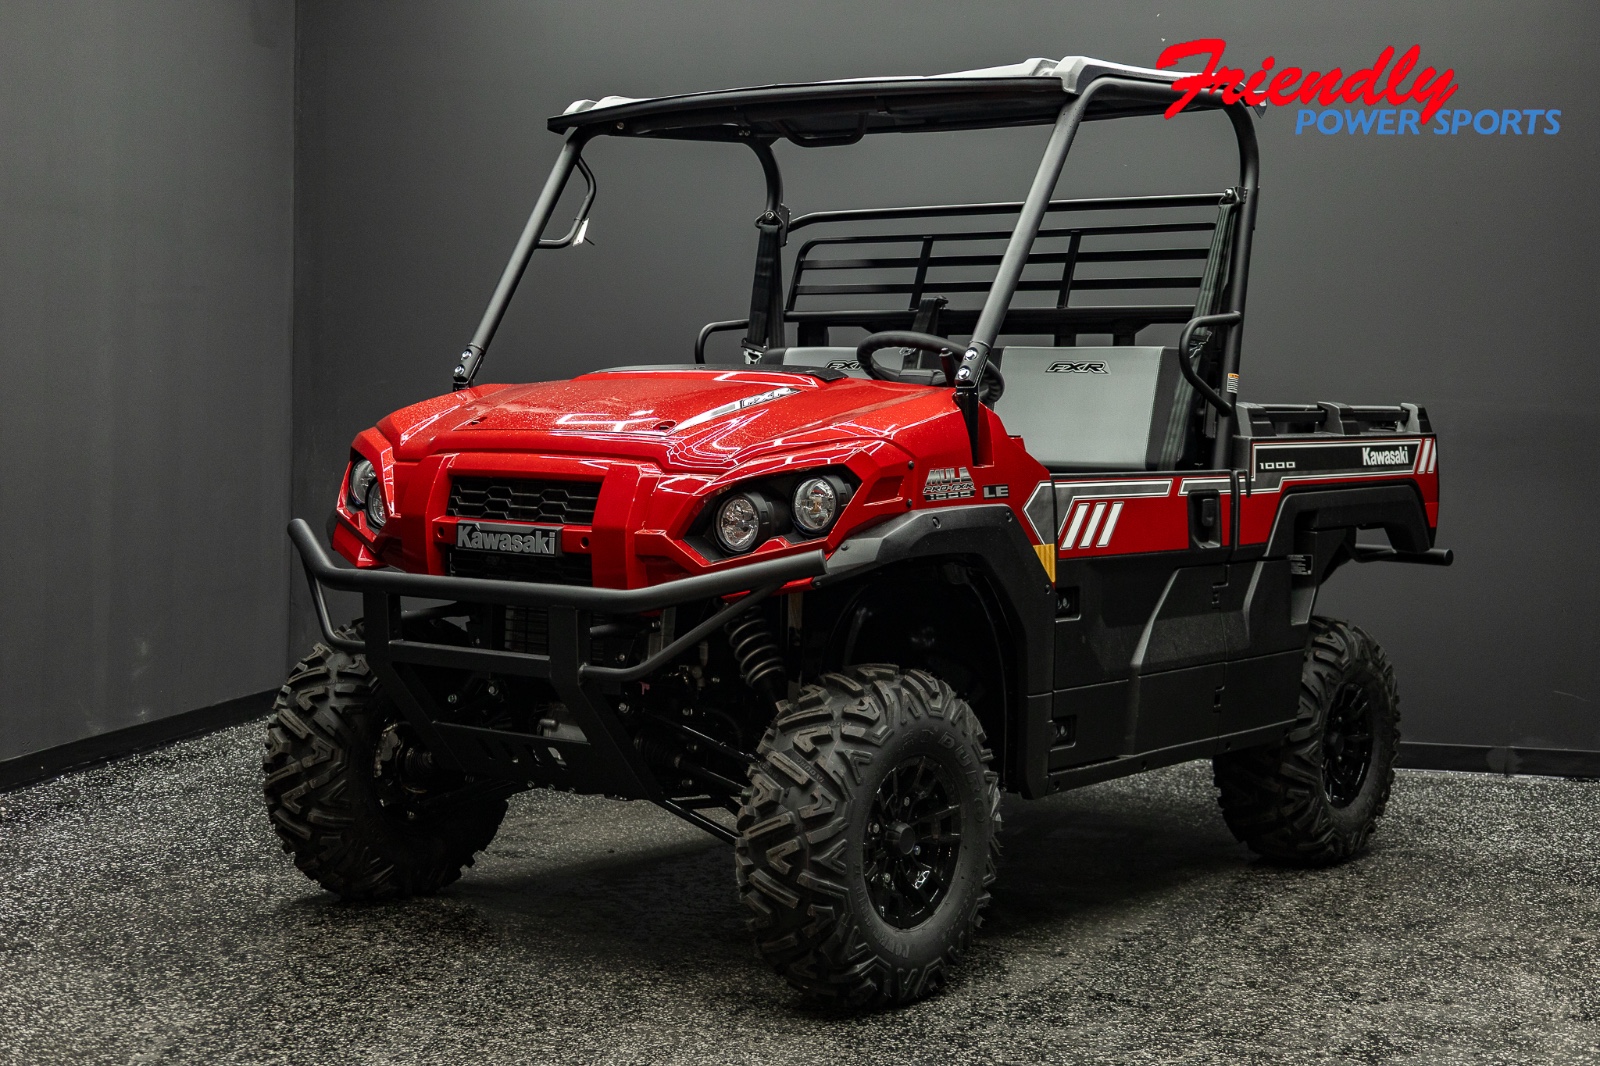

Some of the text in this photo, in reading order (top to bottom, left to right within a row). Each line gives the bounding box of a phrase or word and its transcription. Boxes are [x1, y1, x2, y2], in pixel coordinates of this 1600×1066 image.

[1259, 461, 1296, 470] 1000
[1362, 446, 1409, 466] Kawasaki
[925, 466, 974, 485] MULE
[983, 486, 1009, 499] LE
[457, 525, 556, 555] Kawasaki
